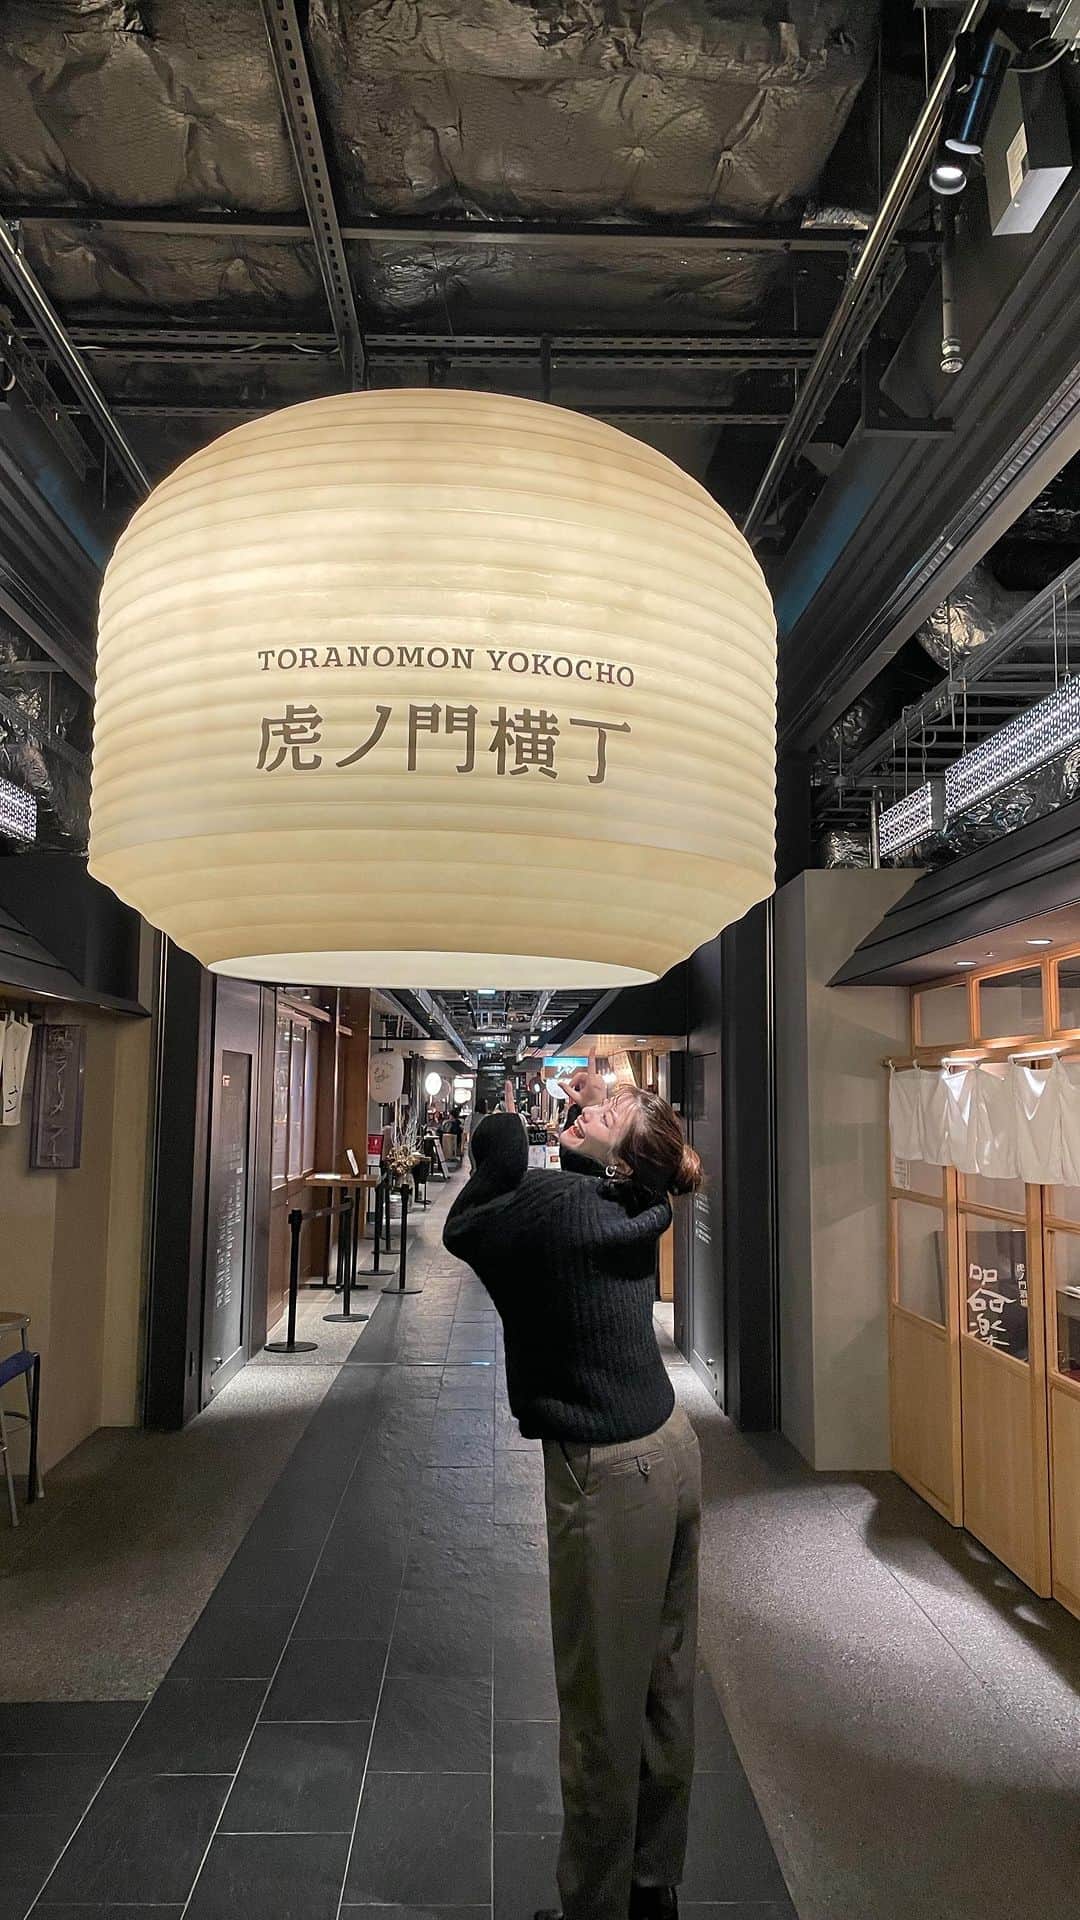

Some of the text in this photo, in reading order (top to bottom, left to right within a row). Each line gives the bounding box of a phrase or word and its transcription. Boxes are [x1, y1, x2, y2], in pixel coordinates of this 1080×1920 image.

[257, 645, 635, 688] TORANOMON YOKOCHO
[256, 702, 632, 784] 虎ノ門横丁
